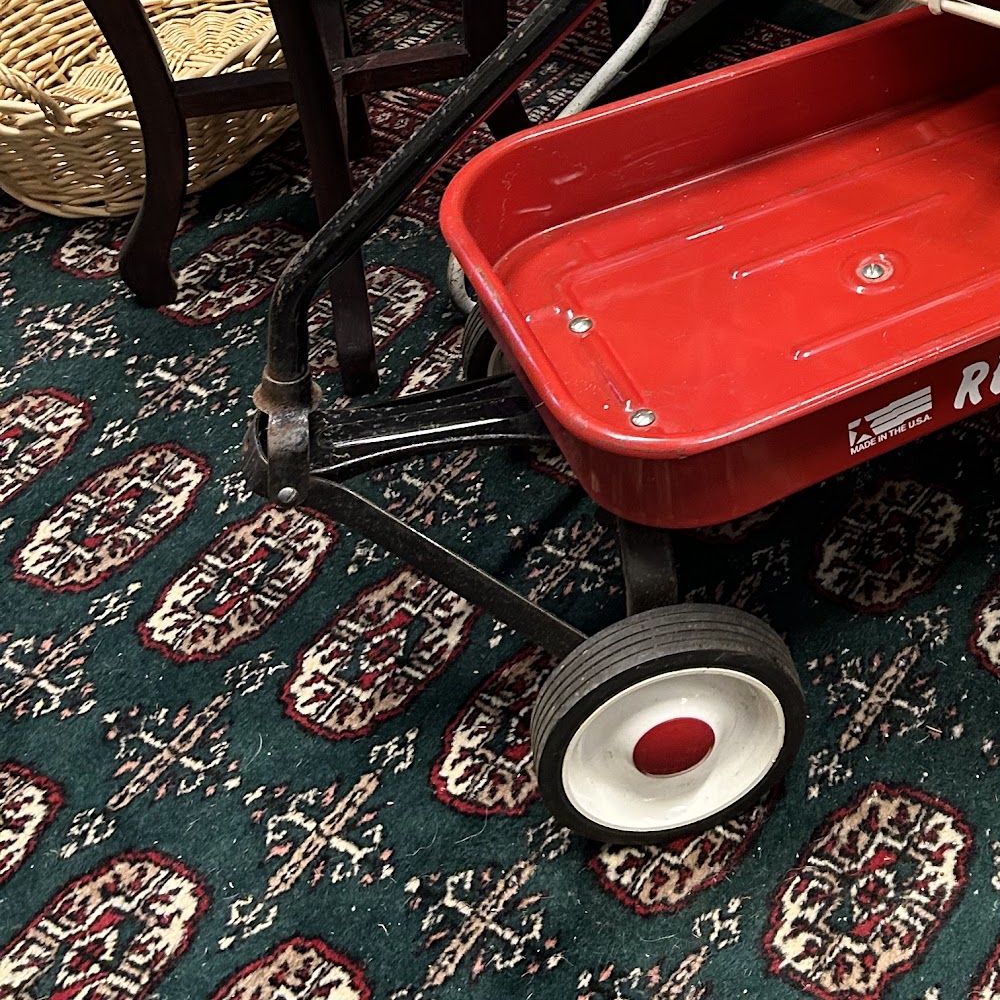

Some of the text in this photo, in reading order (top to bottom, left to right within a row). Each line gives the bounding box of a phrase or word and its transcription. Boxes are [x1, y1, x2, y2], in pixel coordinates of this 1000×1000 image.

[850, 414, 933, 456] MADE IN THE U.S.A.
